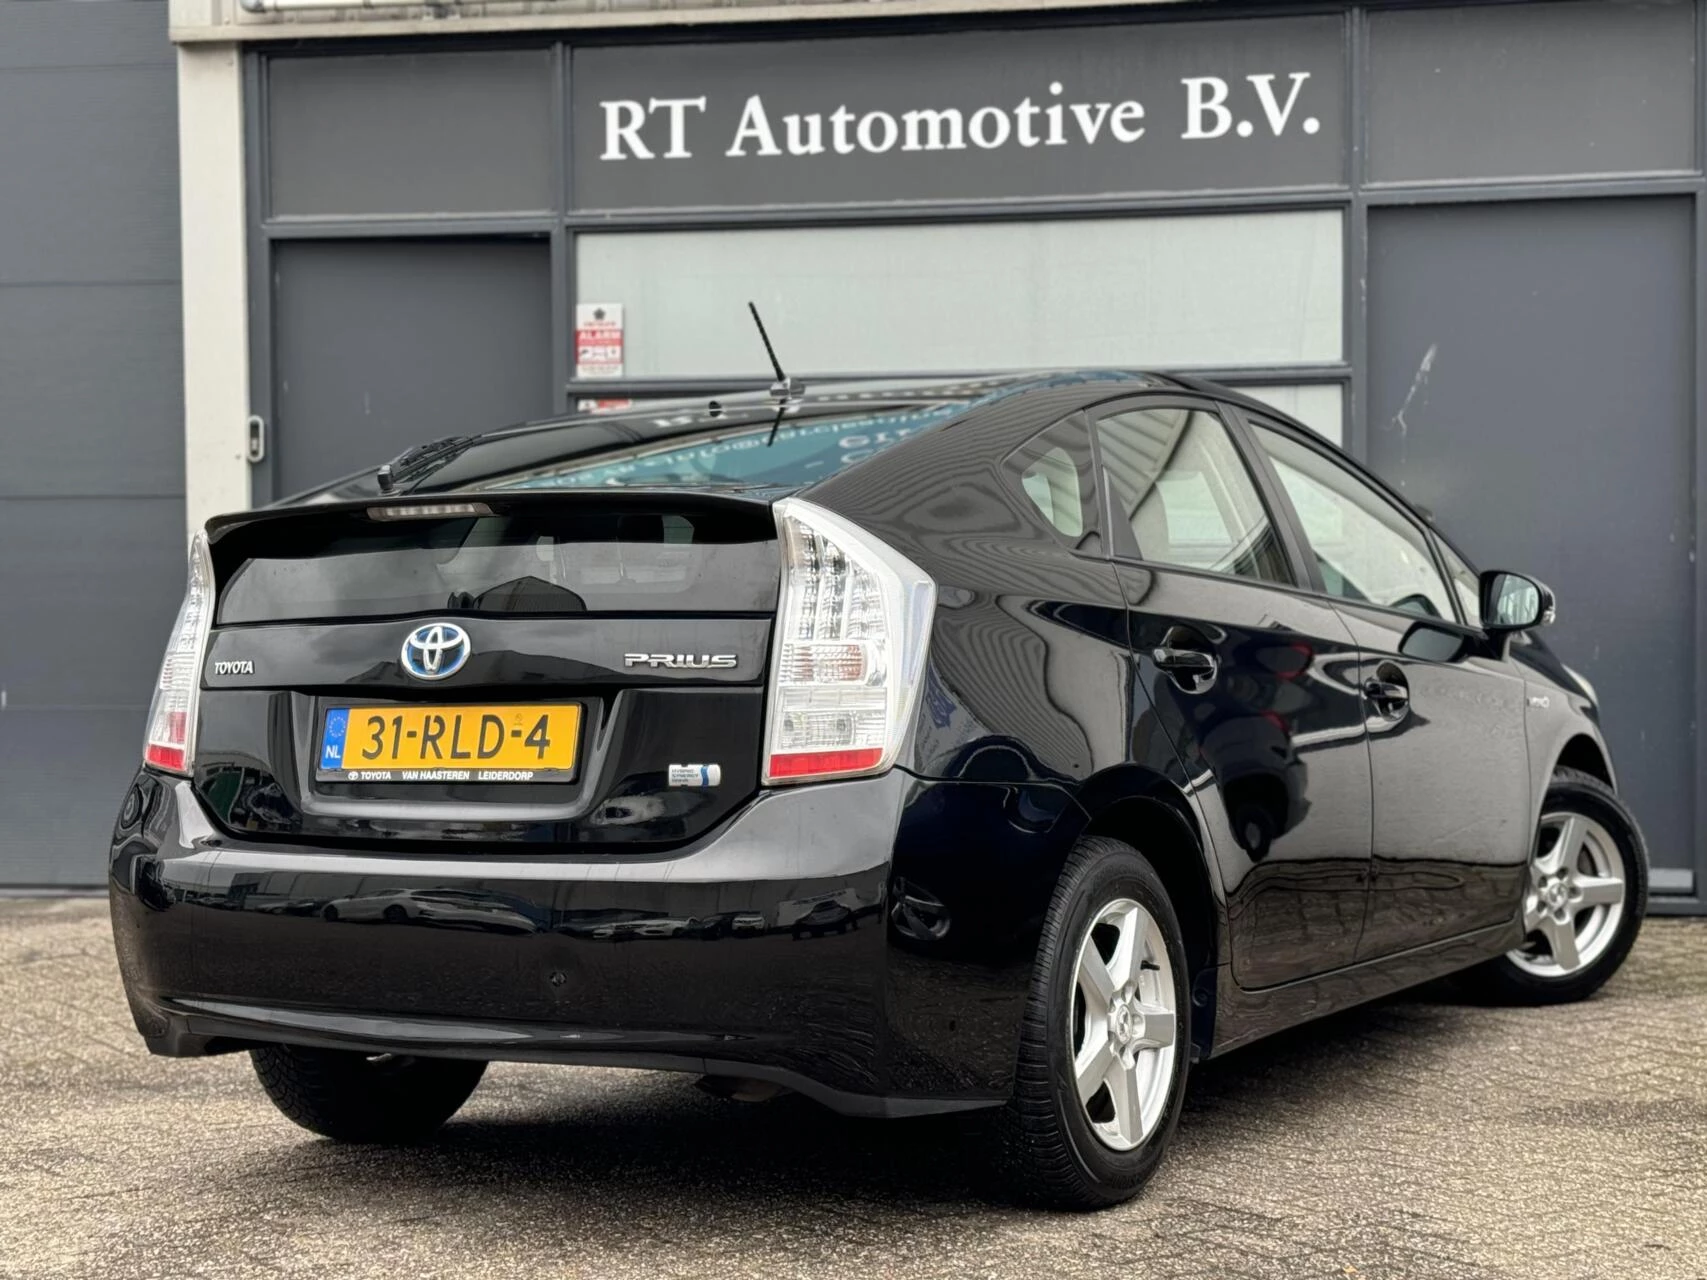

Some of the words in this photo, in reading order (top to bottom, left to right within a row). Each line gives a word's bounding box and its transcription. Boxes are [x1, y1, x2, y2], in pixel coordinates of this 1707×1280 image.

[599, 95, 708, 161] RT
[725, 81, 1146, 158] Automotive
[1180, 71, 1322, 140] B.V.
[214, 659, 254, 675] TOYOTA
[624, 653, 737, 669] PRIUS
[361, 714, 551, 760] 31-RLD-4
[325, 745, 341, 759] NL
[361, 770, 392, 781] TOYOTA
[402, 770, 420, 781] VAN
[419, 769, 470, 781] HAASTEREN
[478, 769, 534, 782] LEIDERDORP
